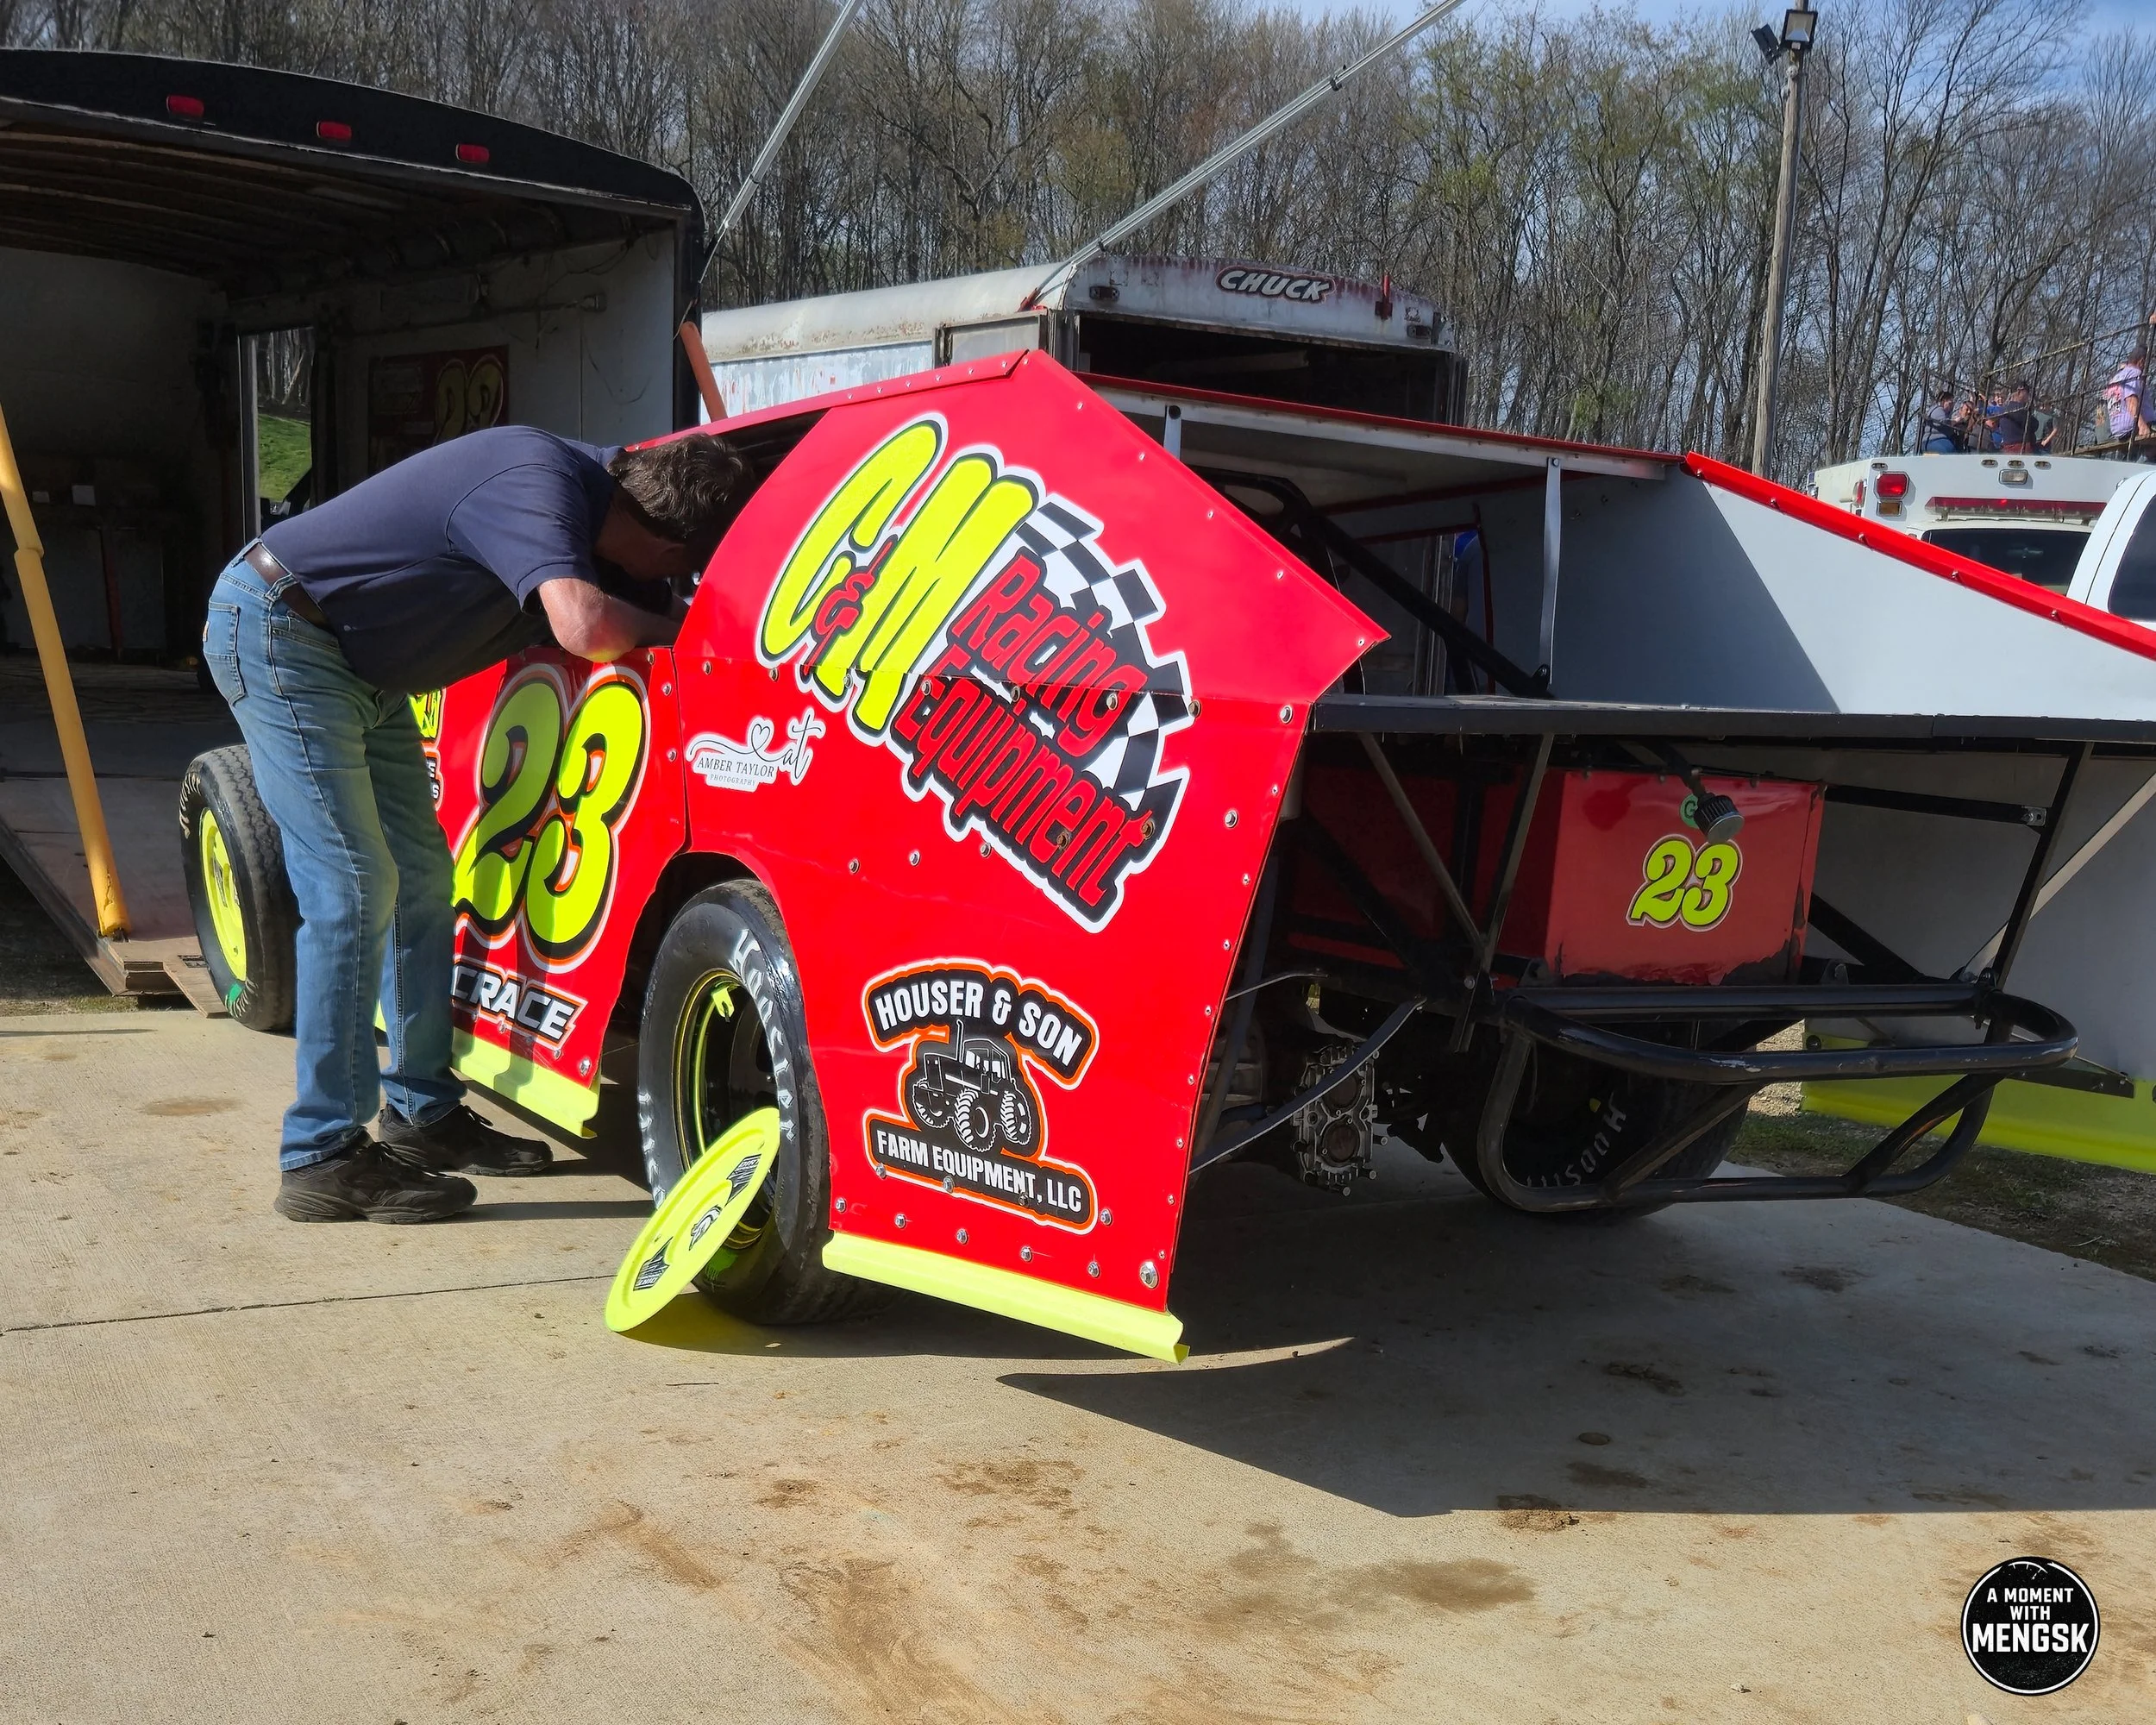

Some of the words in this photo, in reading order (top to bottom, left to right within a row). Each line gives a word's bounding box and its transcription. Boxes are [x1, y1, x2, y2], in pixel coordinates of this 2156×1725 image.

[1220, 269, 1330, 300] CHUCK
[761, 422, 1037, 732] C&M
[951, 553, 1150, 756] Racing
[697, 756, 732, 772] AMBER
[736, 761, 775, 778] TAYLOR
[710, 773, 756, 787] PHOTOGRAPHY
[897, 643, 1155, 907] Equipment
[453, 681, 644, 944] 23
[1630, 840, 1739, 925] 23
[874, 981, 984, 1031] HOUSER
[992, 989, 1012, 1026] &
[1018, 1002, 1082, 1067] SON
[876, 1130, 929, 1167] FARM
[931, 1144, 1043, 1202] EQUIPMENT,
[1047, 1178, 1081, 1212] LLC
